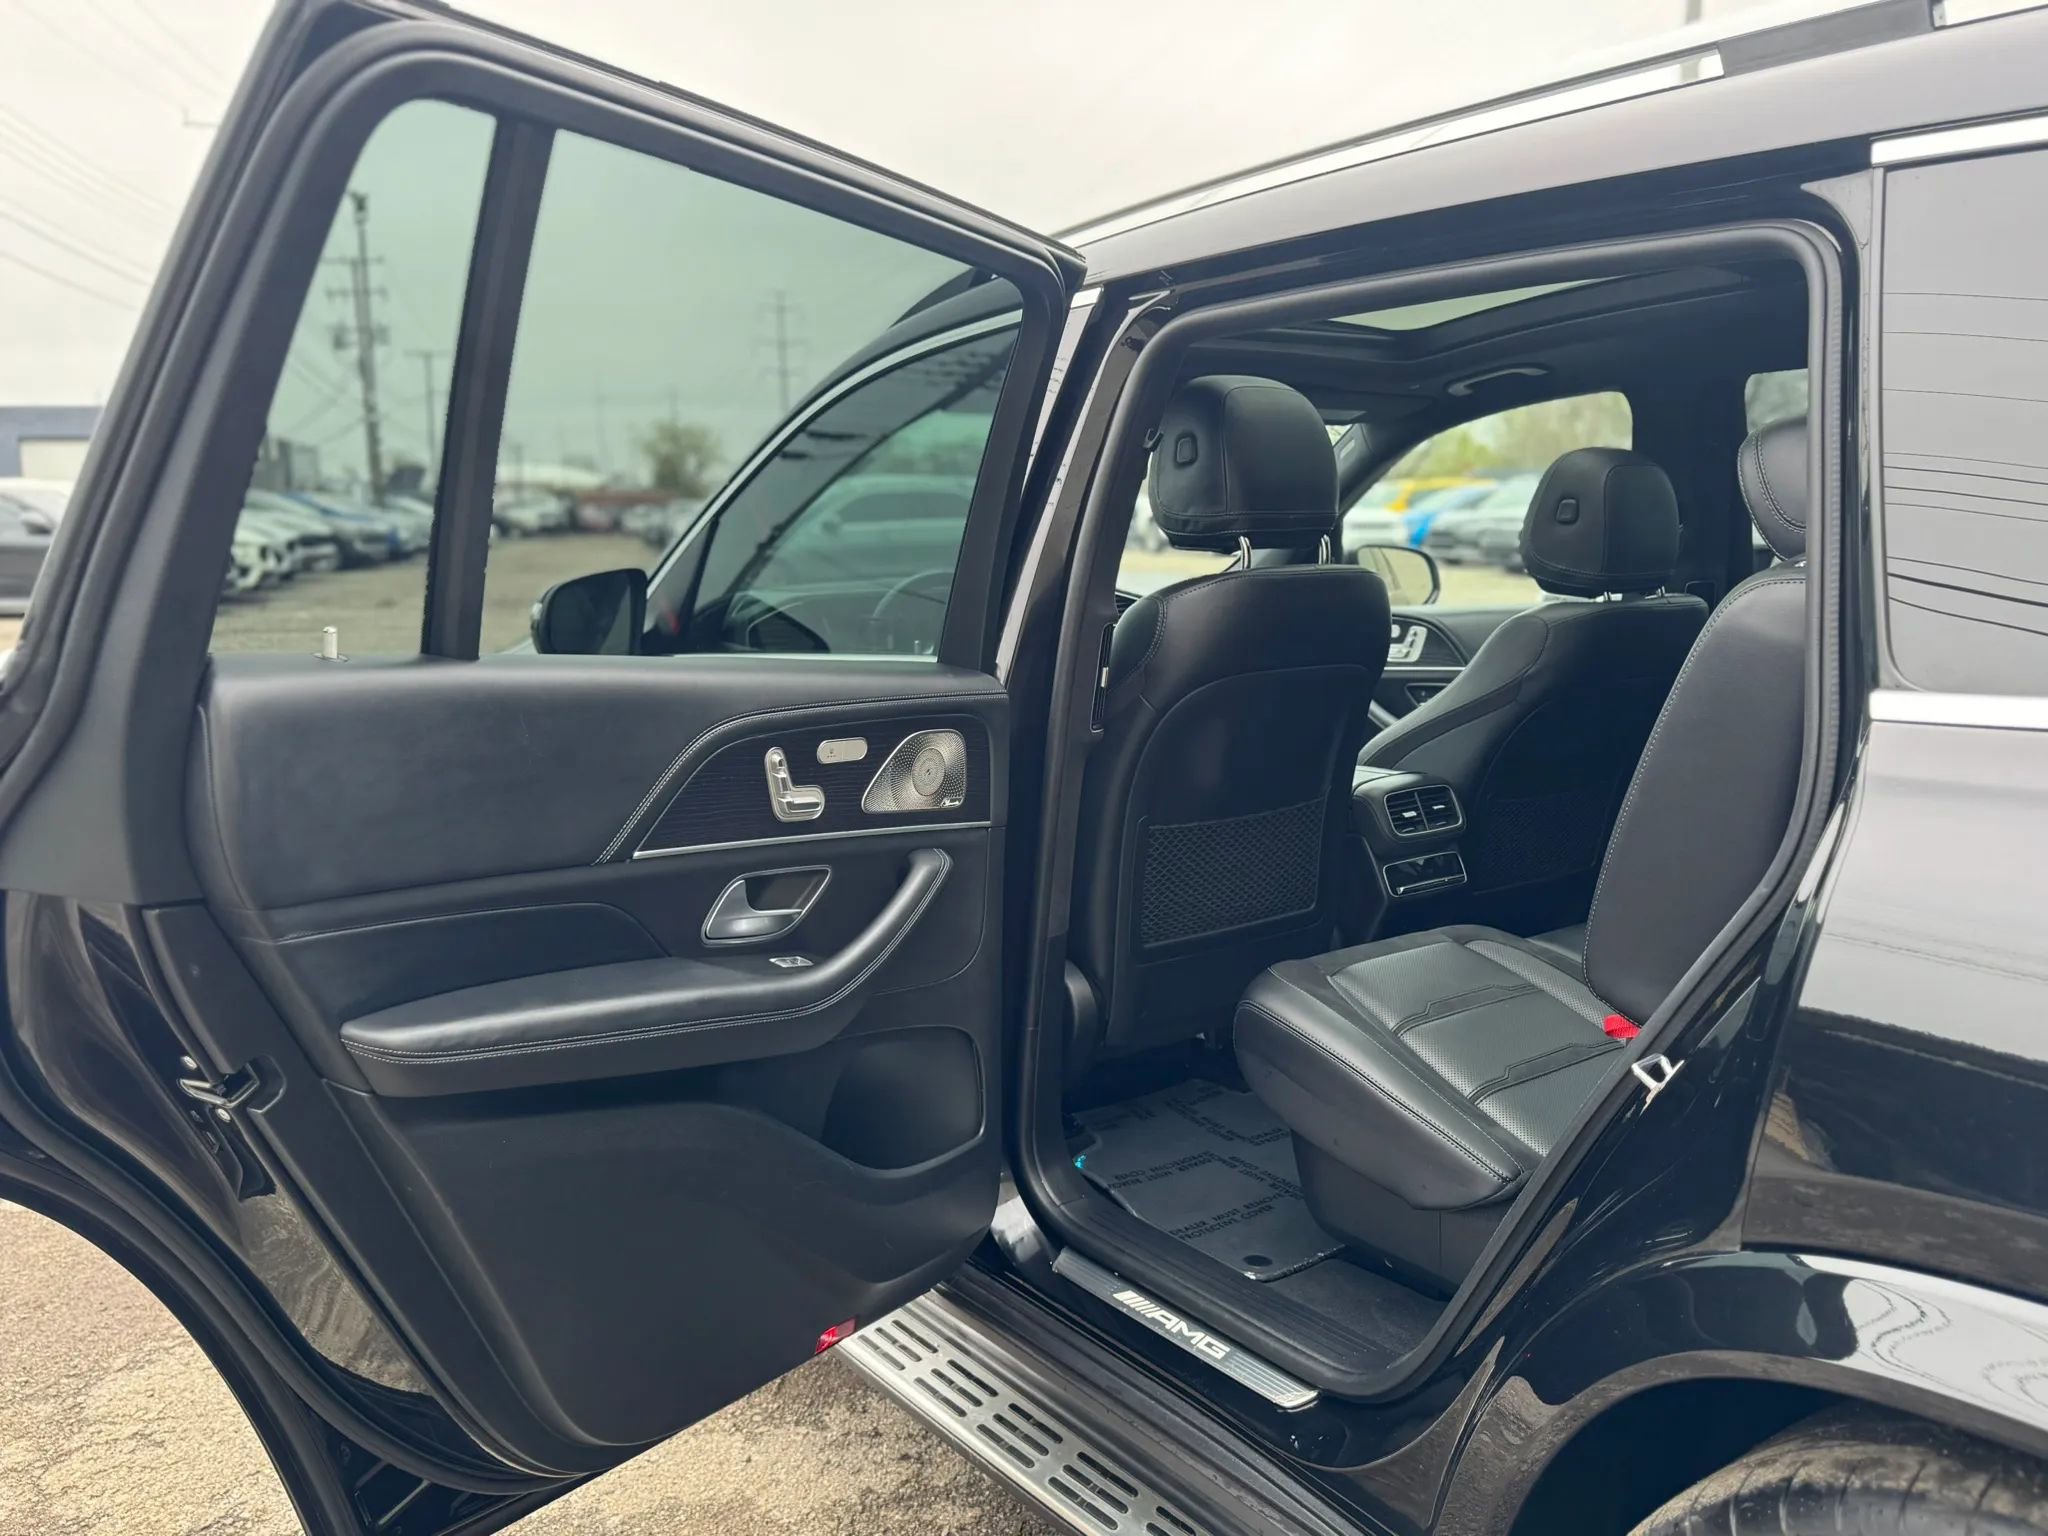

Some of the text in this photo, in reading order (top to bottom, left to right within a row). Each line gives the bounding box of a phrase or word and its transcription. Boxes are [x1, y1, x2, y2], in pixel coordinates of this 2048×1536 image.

[1169, 1221, 1208, 1236] DEALER
[1211, 1209, 1241, 1221] MUST
[1178, 1204, 1275, 1241] PROTECTIVE COVER
[1145, 1307, 1231, 1360] AMG
